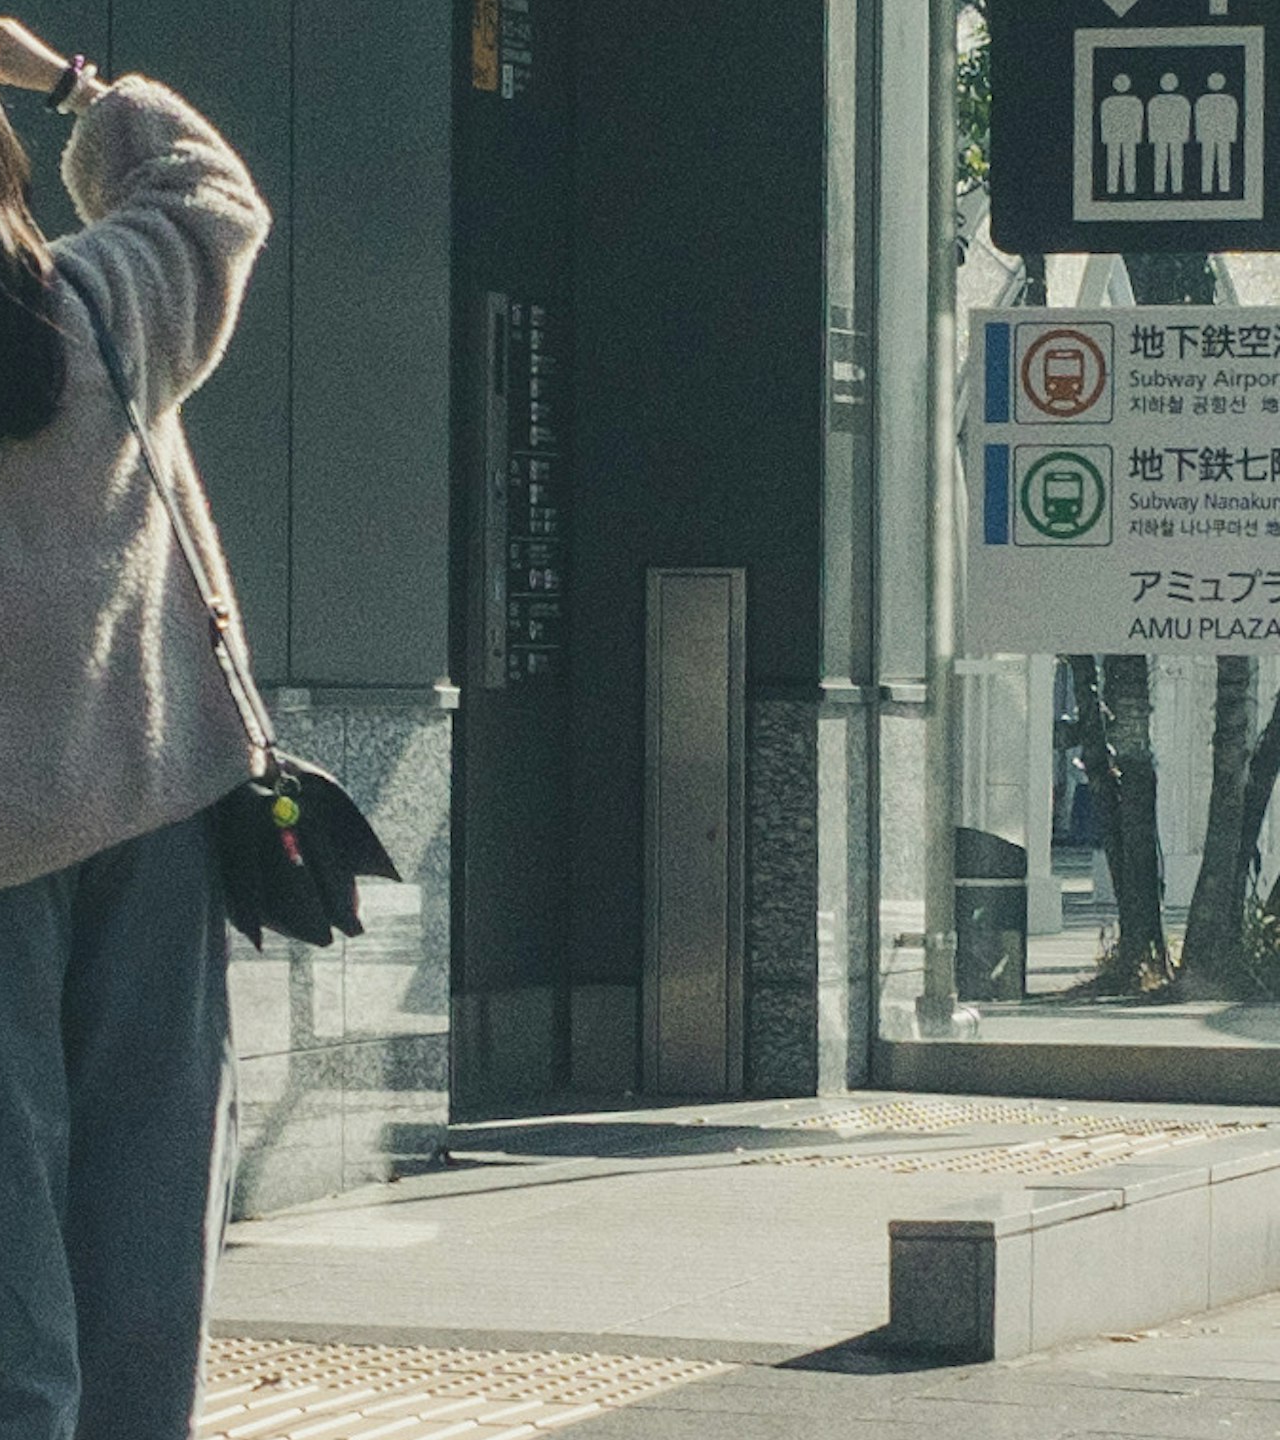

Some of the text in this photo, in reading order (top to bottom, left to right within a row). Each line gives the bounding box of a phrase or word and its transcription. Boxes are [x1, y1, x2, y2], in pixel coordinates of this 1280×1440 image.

[1129, 323, 1280, 359] 地下鉄空
[1129, 369, 1207, 393] Subway
[1128, 445, 1280, 482] 地下鉄七
[1129, 491, 1200, 515] Subway
[1128, 616, 1280, 640] AMU PLAZA
